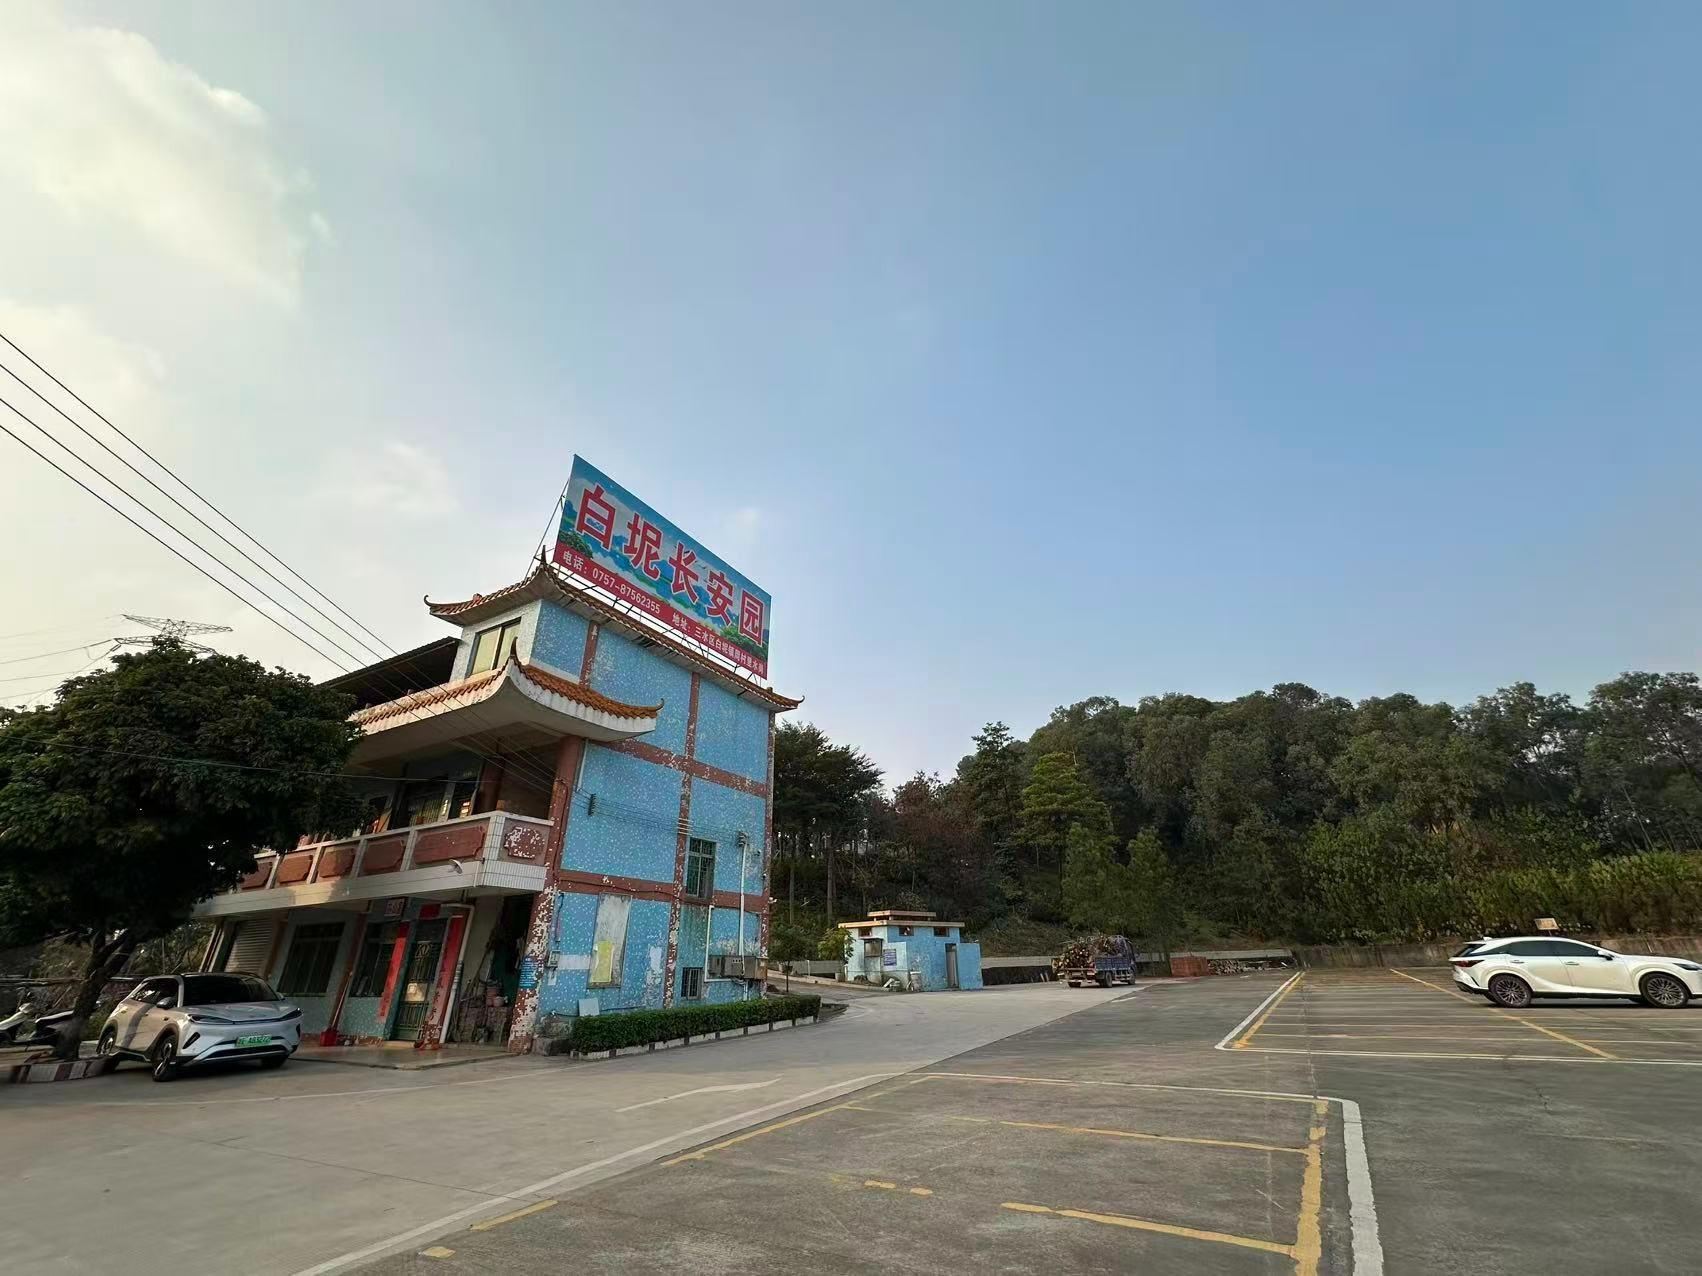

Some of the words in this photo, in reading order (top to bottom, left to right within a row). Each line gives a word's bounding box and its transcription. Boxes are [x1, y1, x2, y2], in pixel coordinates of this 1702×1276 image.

[576, 484, 764, 646] 白坭长安园
